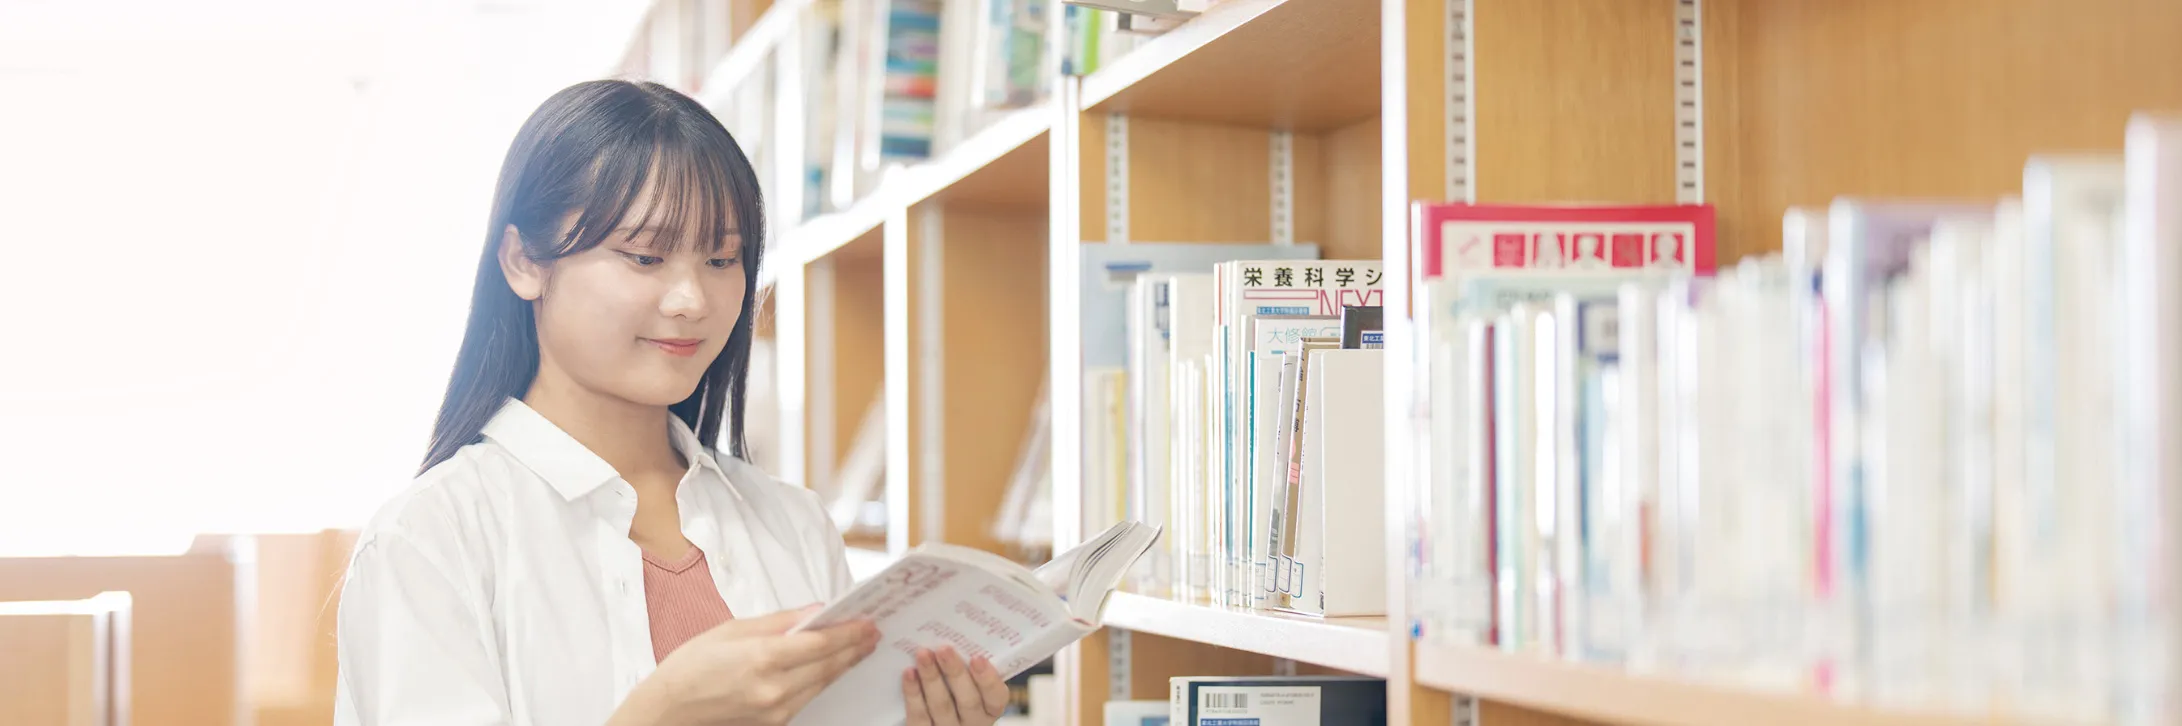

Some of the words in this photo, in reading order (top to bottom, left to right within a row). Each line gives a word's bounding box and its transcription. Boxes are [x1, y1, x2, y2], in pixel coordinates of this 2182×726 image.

[1244, 267, 1383, 287] 栄養科学シ
